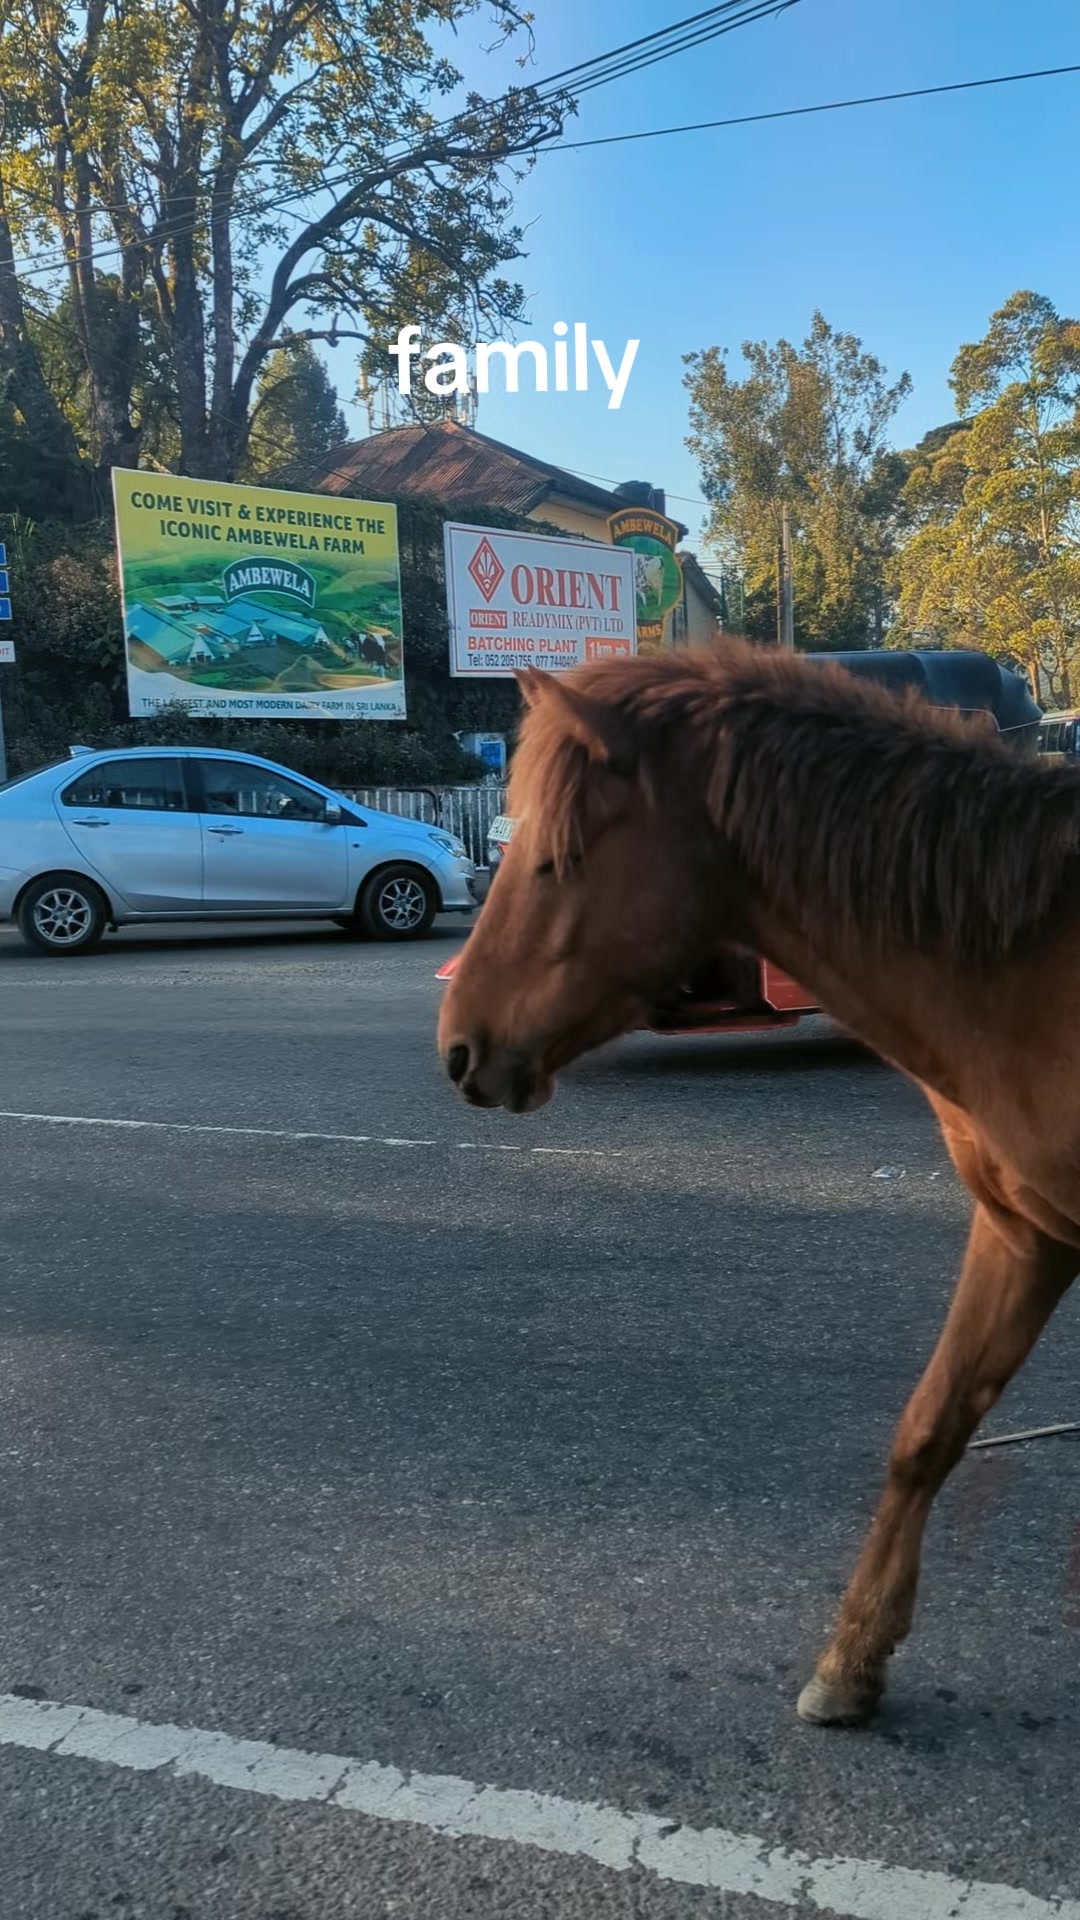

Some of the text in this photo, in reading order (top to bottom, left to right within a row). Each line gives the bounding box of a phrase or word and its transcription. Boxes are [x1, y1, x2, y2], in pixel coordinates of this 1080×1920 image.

[131, 491, 385, 535] COME VISIT & EXPERIENCE THE
[160, 519, 365, 555] ICONIC AMBEWELA FARM
[614, 518, 673, 546] AMBEWELA
[229, 566, 311, 598] AMBEWELA
[511, 563, 623, 612] ORIENT
[470, 611, 624, 633] ORIENT READYMIX (PVT) LTD
[468, 636, 578, 653] BATCHING PLANT
[467, 653, 483, 667] Tel:
[485, 654, 499, 667] 052
[536, 655, 549, 668] 077
[142, 698, 160, 708] THE
[206, 699, 227, 709] AND
[229, 700, 254, 709] MOST
[256, 700, 293, 710] MODERN
[322, 701, 344, 711] FARM
[346, 701, 355, 711] IN
[356, 702, 369, 711] SRI
[370, 703, 396, 711] LANKA
